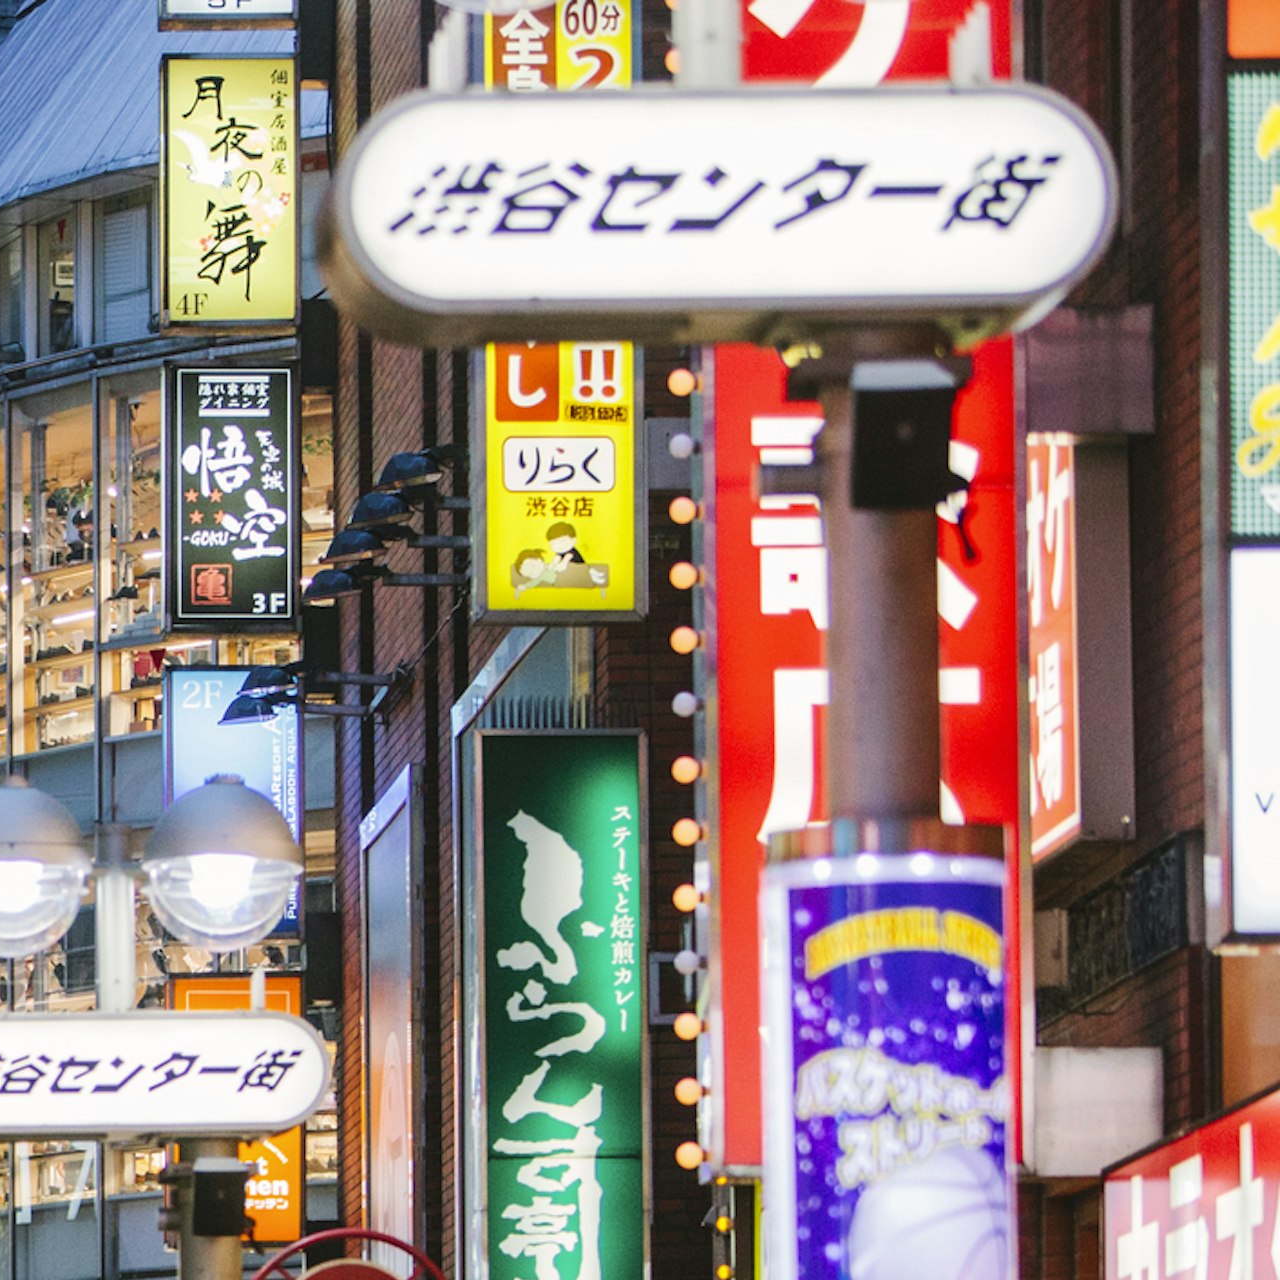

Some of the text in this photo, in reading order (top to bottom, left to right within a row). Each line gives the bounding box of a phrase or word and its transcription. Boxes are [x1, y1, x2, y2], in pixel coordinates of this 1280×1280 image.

[268, 67, 290, 176] 個室居酒屋
[182, 75, 268, 302] 月夜の舞
[388, 153, 1065, 235] 渋谷センター街
[176, 293, 209, 316] 4F
[199, 397, 270, 409] ダイニング
[518, 447, 602, 485] りらく
[181, 425, 287, 560] 悟空
[526, 497, 594, 517] 渋谷店
[252, 592, 286, 614] 3F
[182, 680, 223, 709] 2F
[610, 806, 636, 1032] ステーキと焙煎カレー
